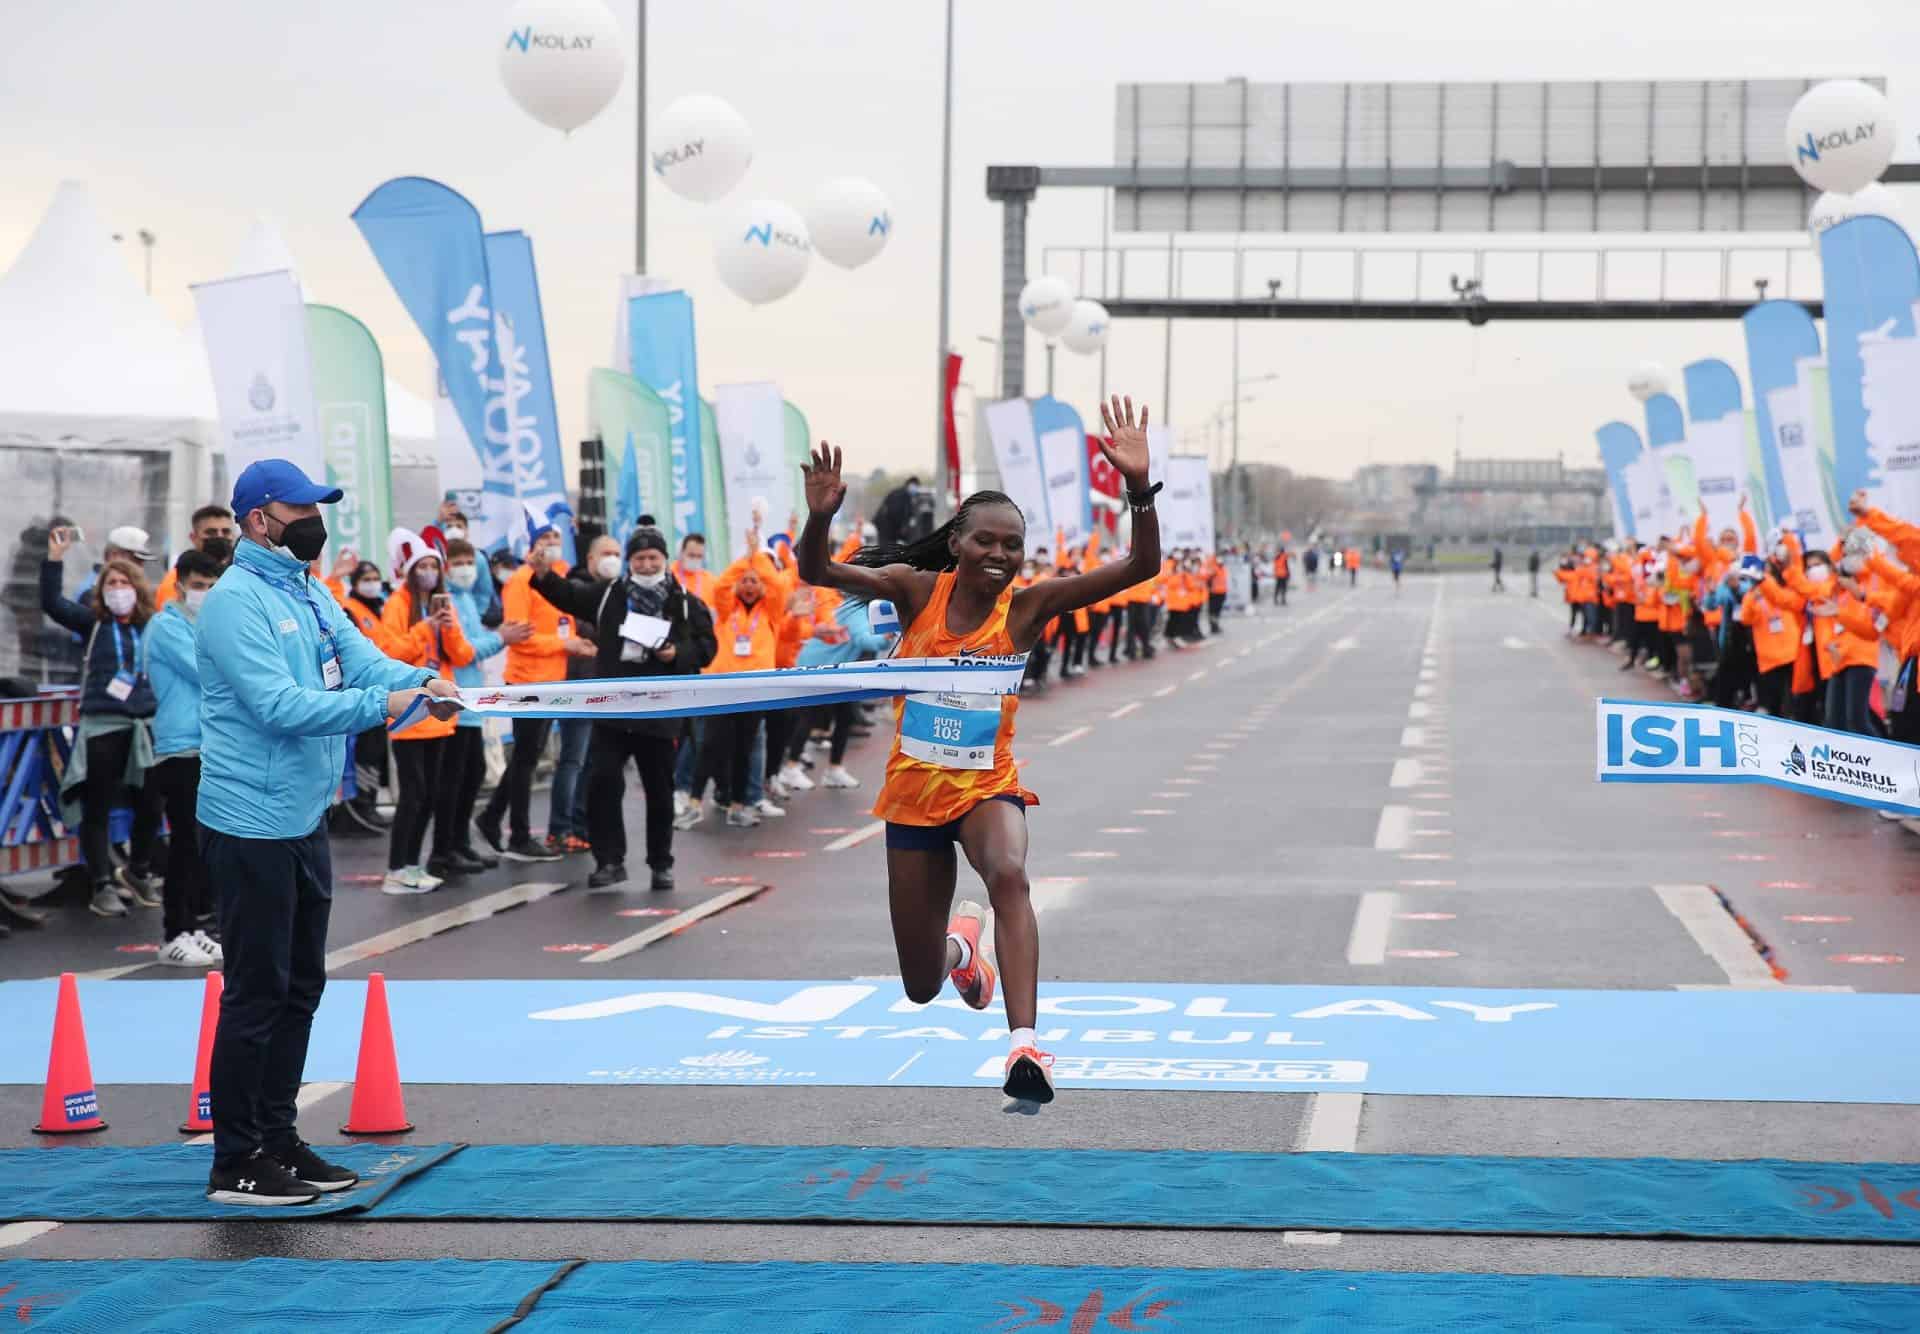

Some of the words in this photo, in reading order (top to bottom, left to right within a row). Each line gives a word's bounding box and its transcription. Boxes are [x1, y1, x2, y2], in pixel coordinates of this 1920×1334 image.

[933, 726, 961, 741] 103
[934, 716, 962, 728] RUTH
[1607, 713, 1737, 768] ISH
[1738, 720, 1761, 769] 2021
[1811, 759, 1897, 787] ISTANBUL
[1812, 771, 1838, 781] HALF
[1840, 777, 1898, 794] MARATHON
